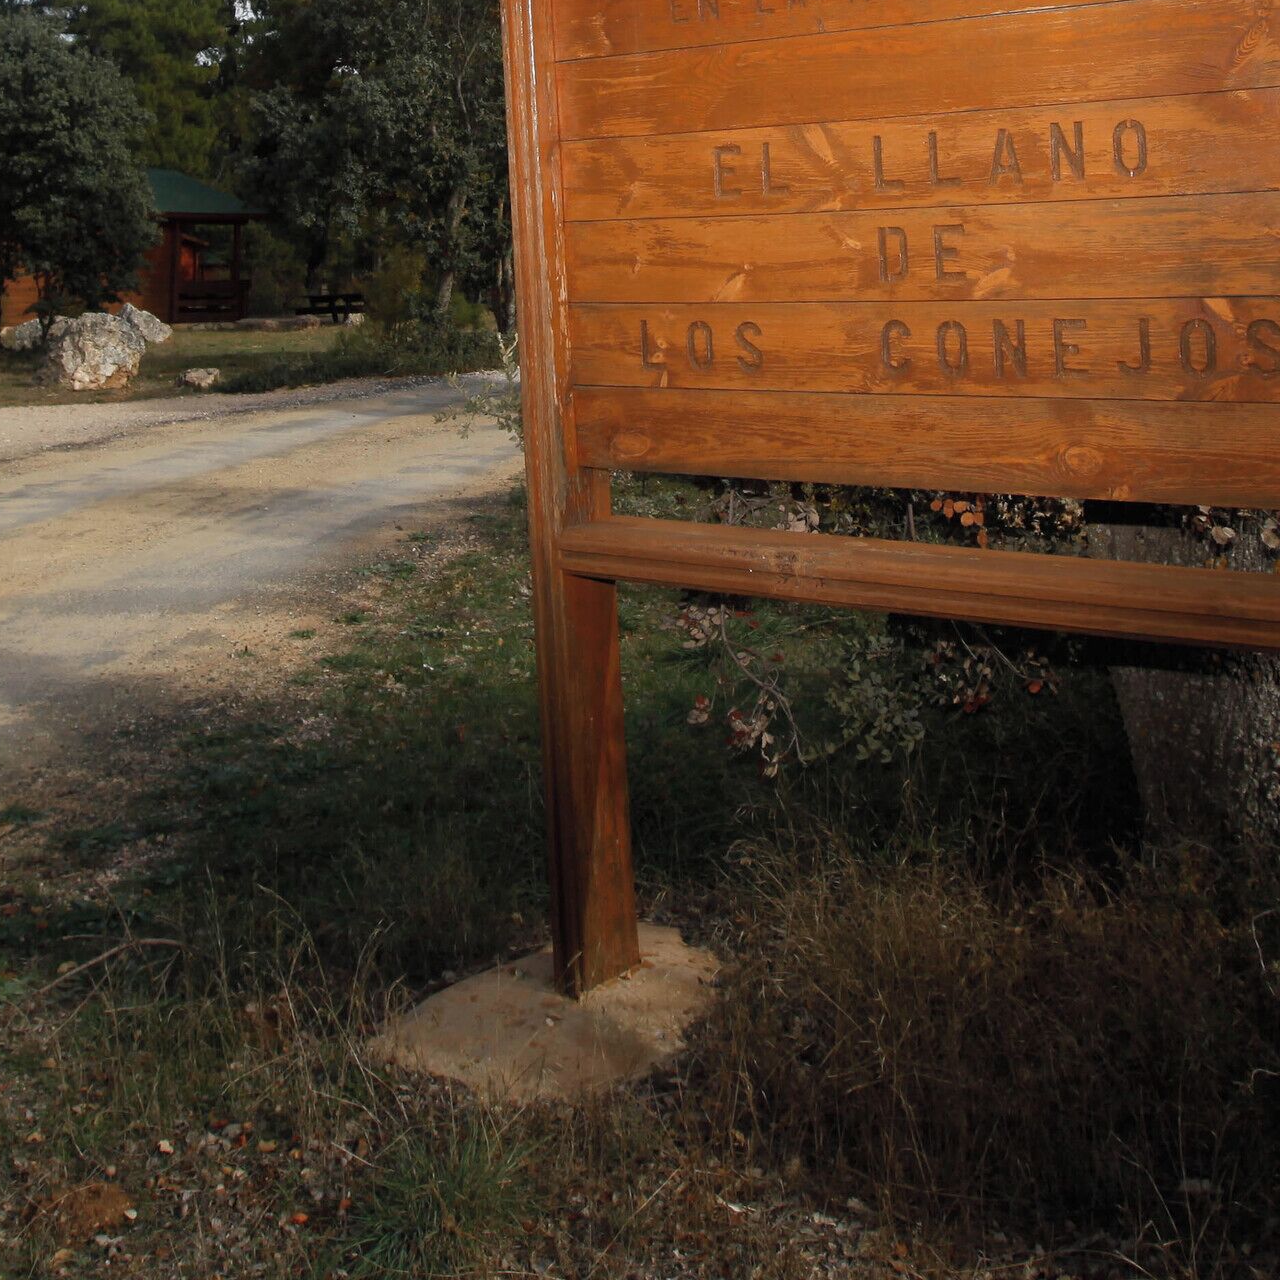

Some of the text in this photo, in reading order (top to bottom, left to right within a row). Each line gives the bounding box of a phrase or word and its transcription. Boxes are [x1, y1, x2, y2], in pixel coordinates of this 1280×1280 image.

[713, 118, 1149, 199] EL LLANO
[877, 222, 969, 285] DE
[639, 319, 766, 374] LOS
